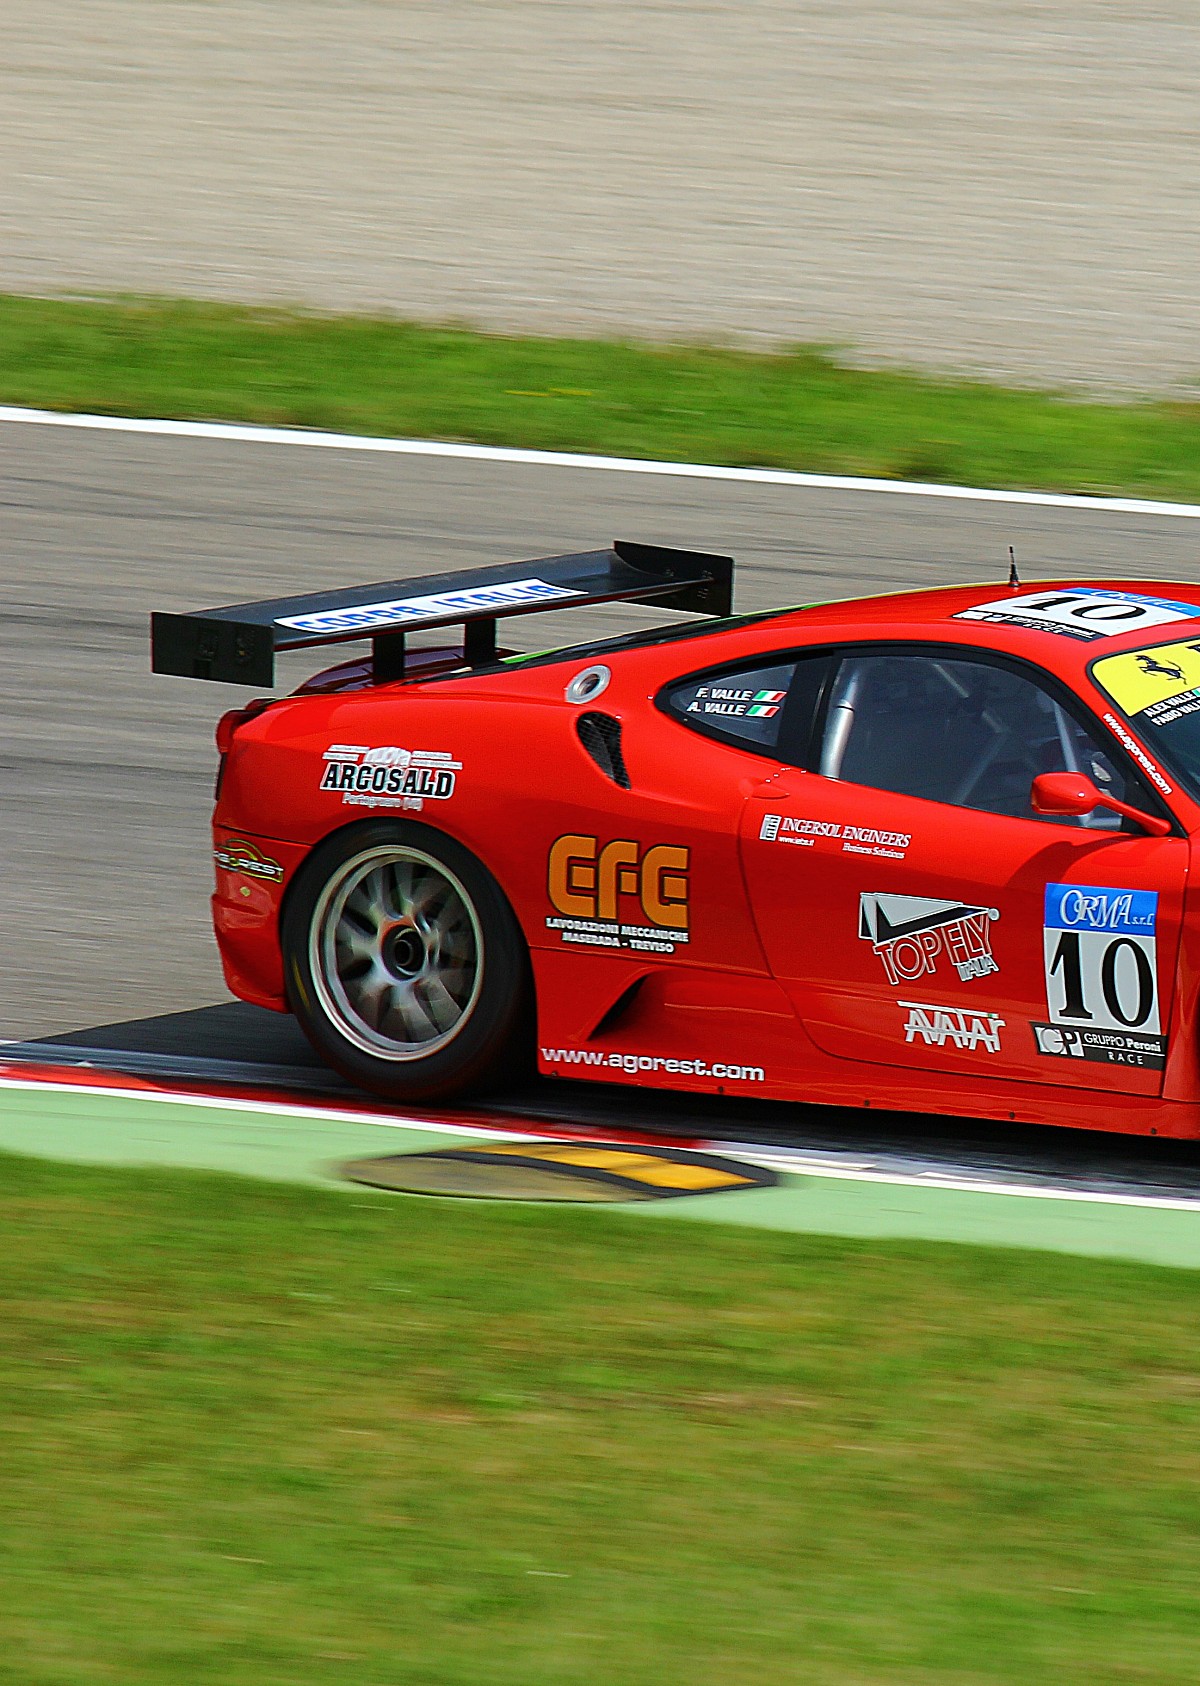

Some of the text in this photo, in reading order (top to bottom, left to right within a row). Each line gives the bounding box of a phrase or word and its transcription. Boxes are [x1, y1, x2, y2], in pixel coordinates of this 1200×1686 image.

[291, 584, 574, 631] COPPA ITALIA
[1013, 596, 1148, 621] 10
[695, 687, 753, 701] F. VALLE
[1143, 691, 1197, 718] ALEX VALLE
[686, 702, 746, 716] A. VALLE
[1151, 709, 1183, 726] FABIO
[1102, 712, 1173, 795] www.agorest.com
[780, 817, 912, 848] INGERSOL ENGINEERS
[1060, 889, 1134, 928] ORMA
[545, 917, 689, 943] LAVORAZIONI MECCANICHE
[562, 931, 621, 948] MASERADA
[629, 939, 675, 953] TREVISO
[872, 914, 993, 986] TOP FLY
[1049, 931, 1154, 1028] 10
[1083, 1033, 1162, 1053] GRUPPO Peroni
[541, 1047, 766, 1082] www.agorest.com
[1107, 1051, 1144, 1065] RACE
